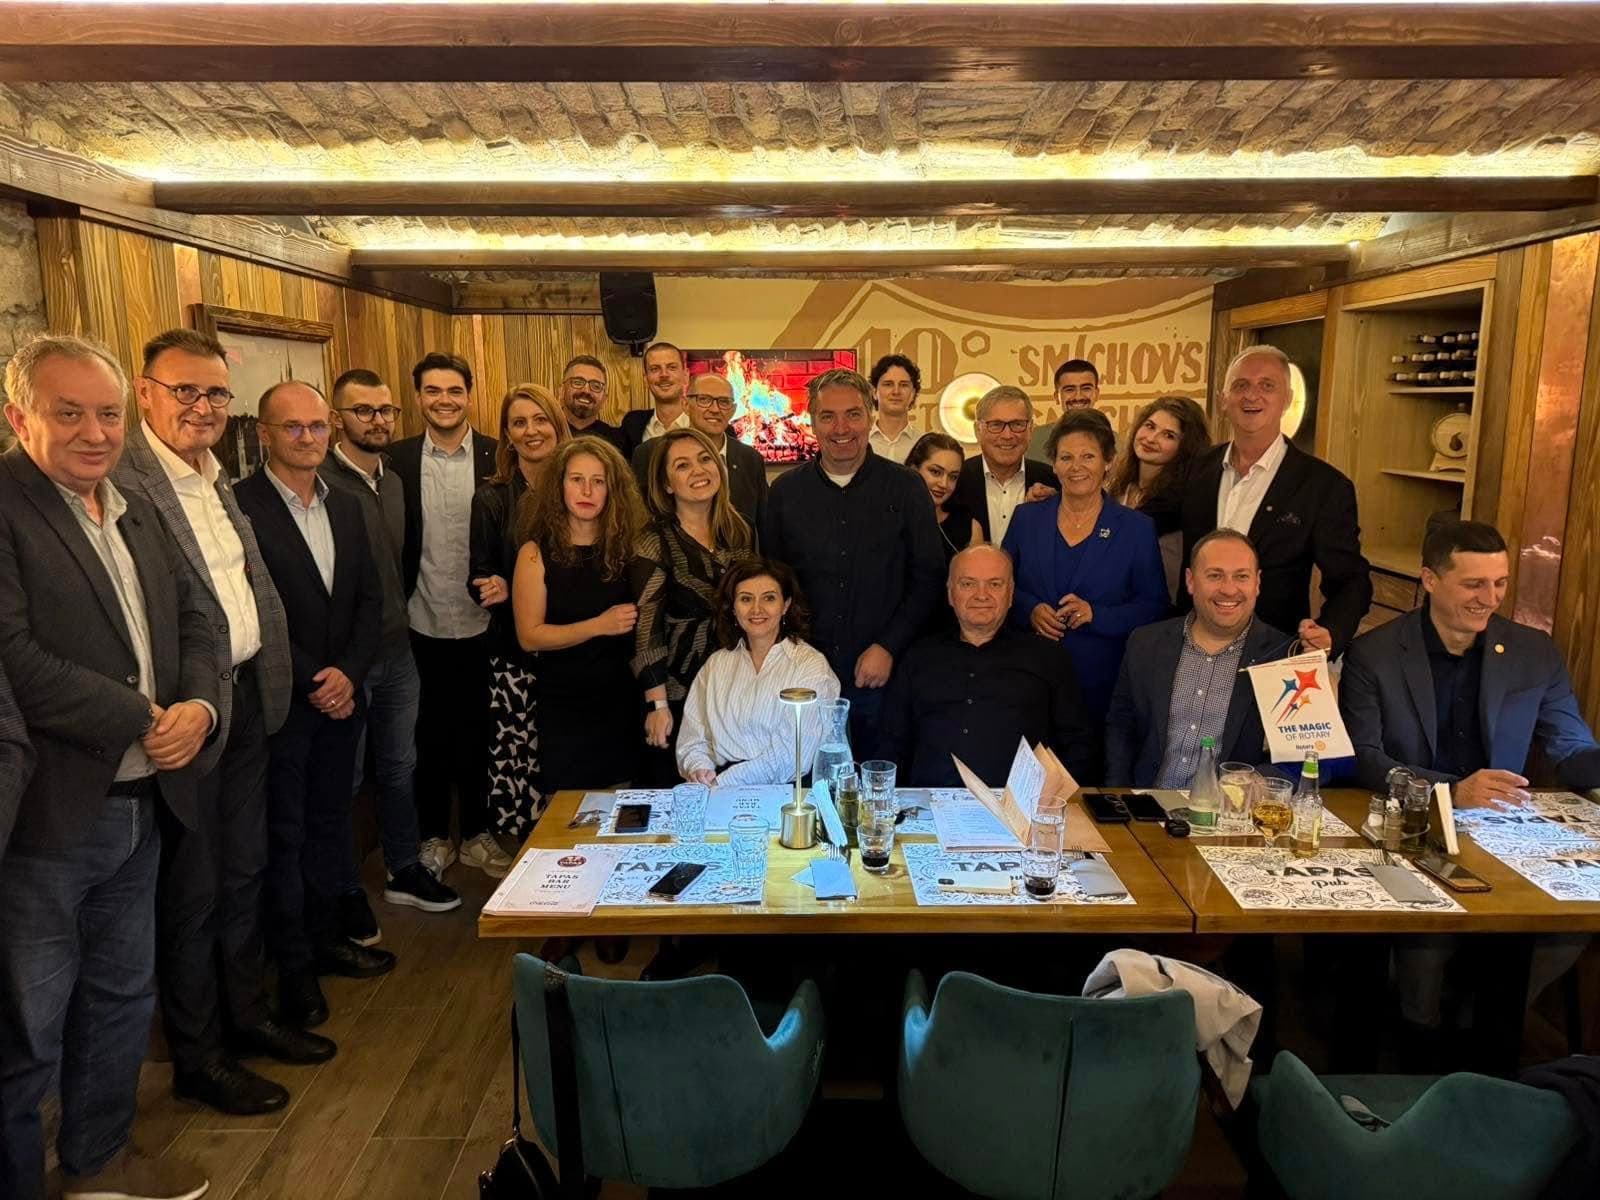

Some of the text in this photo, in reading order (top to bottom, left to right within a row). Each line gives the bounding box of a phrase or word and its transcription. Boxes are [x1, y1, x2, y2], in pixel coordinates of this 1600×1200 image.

[1278, 722, 1332, 734] THE MAGIC
[1285, 731, 1331, 741] OF ROTARY
[1482, 815, 1591, 824] TAPAS
[613, 861, 723, 872] TAPS
[1546, 859, 1600, 868] TA
[1312, 878, 1350, 888] Pub
